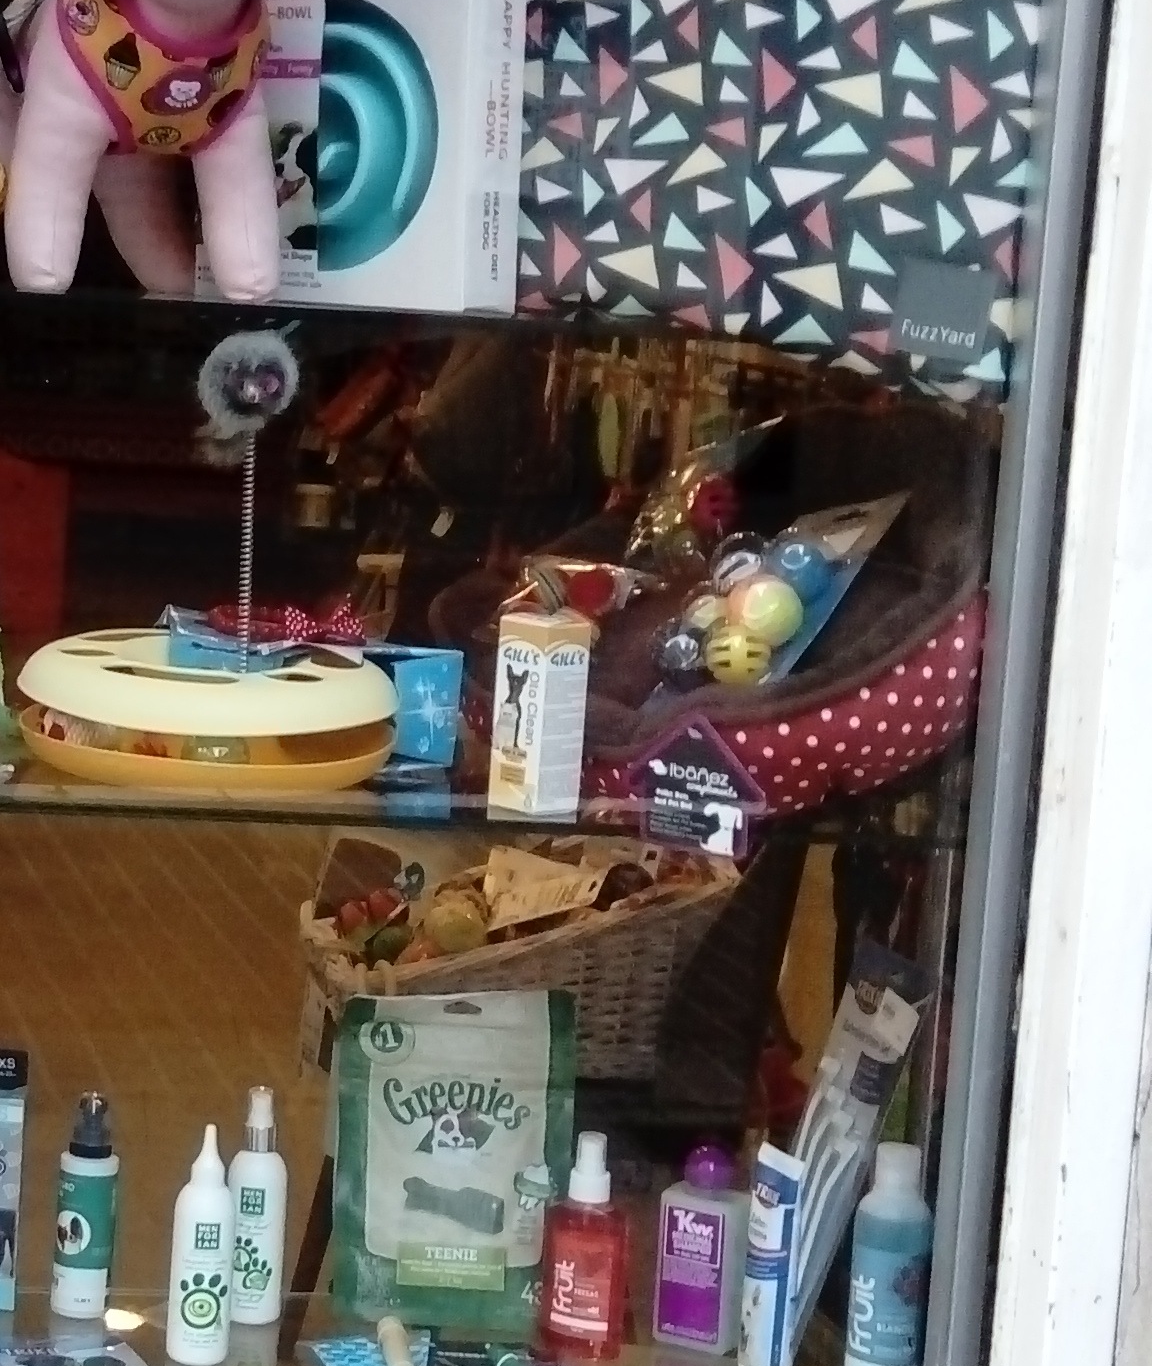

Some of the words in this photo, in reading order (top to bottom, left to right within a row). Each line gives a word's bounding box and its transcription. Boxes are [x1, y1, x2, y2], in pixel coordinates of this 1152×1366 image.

[498, 61, 512, 161] HUNTING
[901, 318, 976, 349] FuzzYard
[525, 701, 539, 746] Clean
[382, 1077, 531, 1131] Greenies
[424, 1246, 478, 1262] TEENIE
